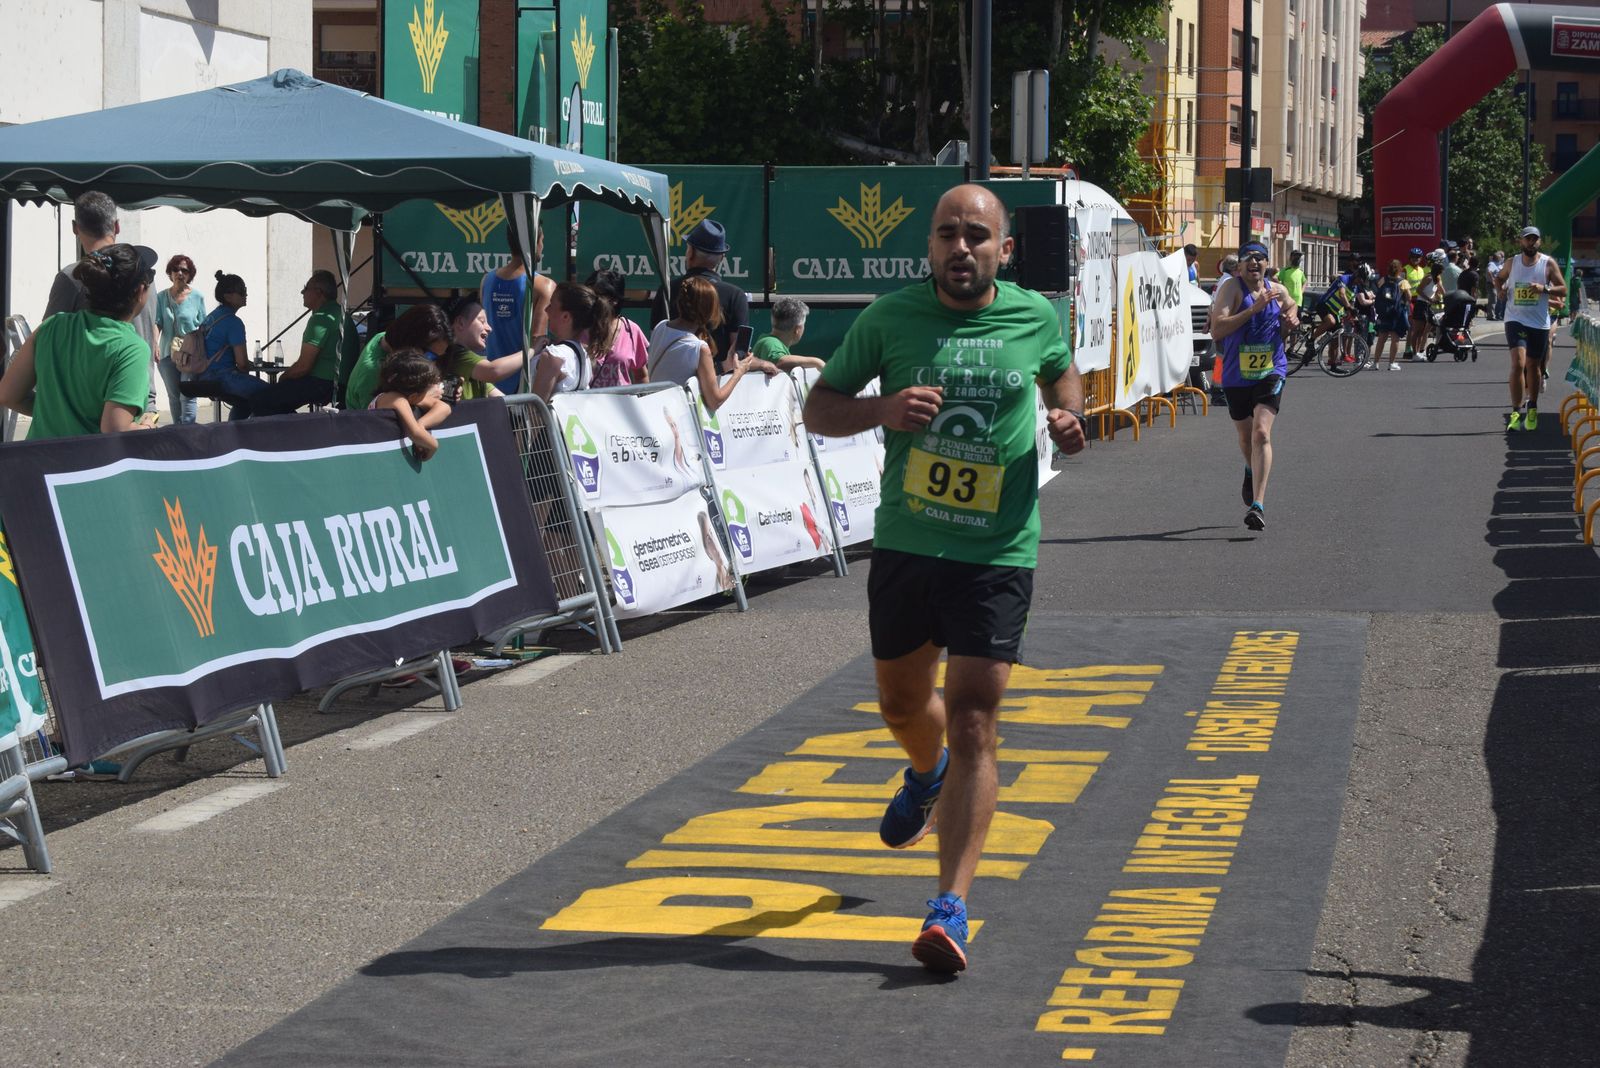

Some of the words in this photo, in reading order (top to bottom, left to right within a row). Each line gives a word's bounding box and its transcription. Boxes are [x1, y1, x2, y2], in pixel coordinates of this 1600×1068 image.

[1392, 222, 1433, 231] ZAMORA
[401, 251, 459, 274] CAJA
[593, 254, 655, 276] CAJA
[792, 257, 854, 280] CAJA
[862, 257, 932, 279] RURA
[1517, 289, 1534, 299] 132
[957, 338, 1003, 348] CARRERA
[1249, 354, 1267, 369] 22
[955, 388, 1002, 399] ZAMORA
[964, 452, 995, 464] RURAL
[927, 461, 978, 503] 93
[953, 514, 990, 528] RURAL
[230, 520, 336, 617] CAJA
[324, 500, 459, 598] RURAL
[1210, 630, 1299, 696] INTERIORES
[1184, 700, 1282, 752] DISEÑO
[1121, 774, 1261, 875] INTEGRAL
[1034, 886, 1222, 1035] REFORMA
